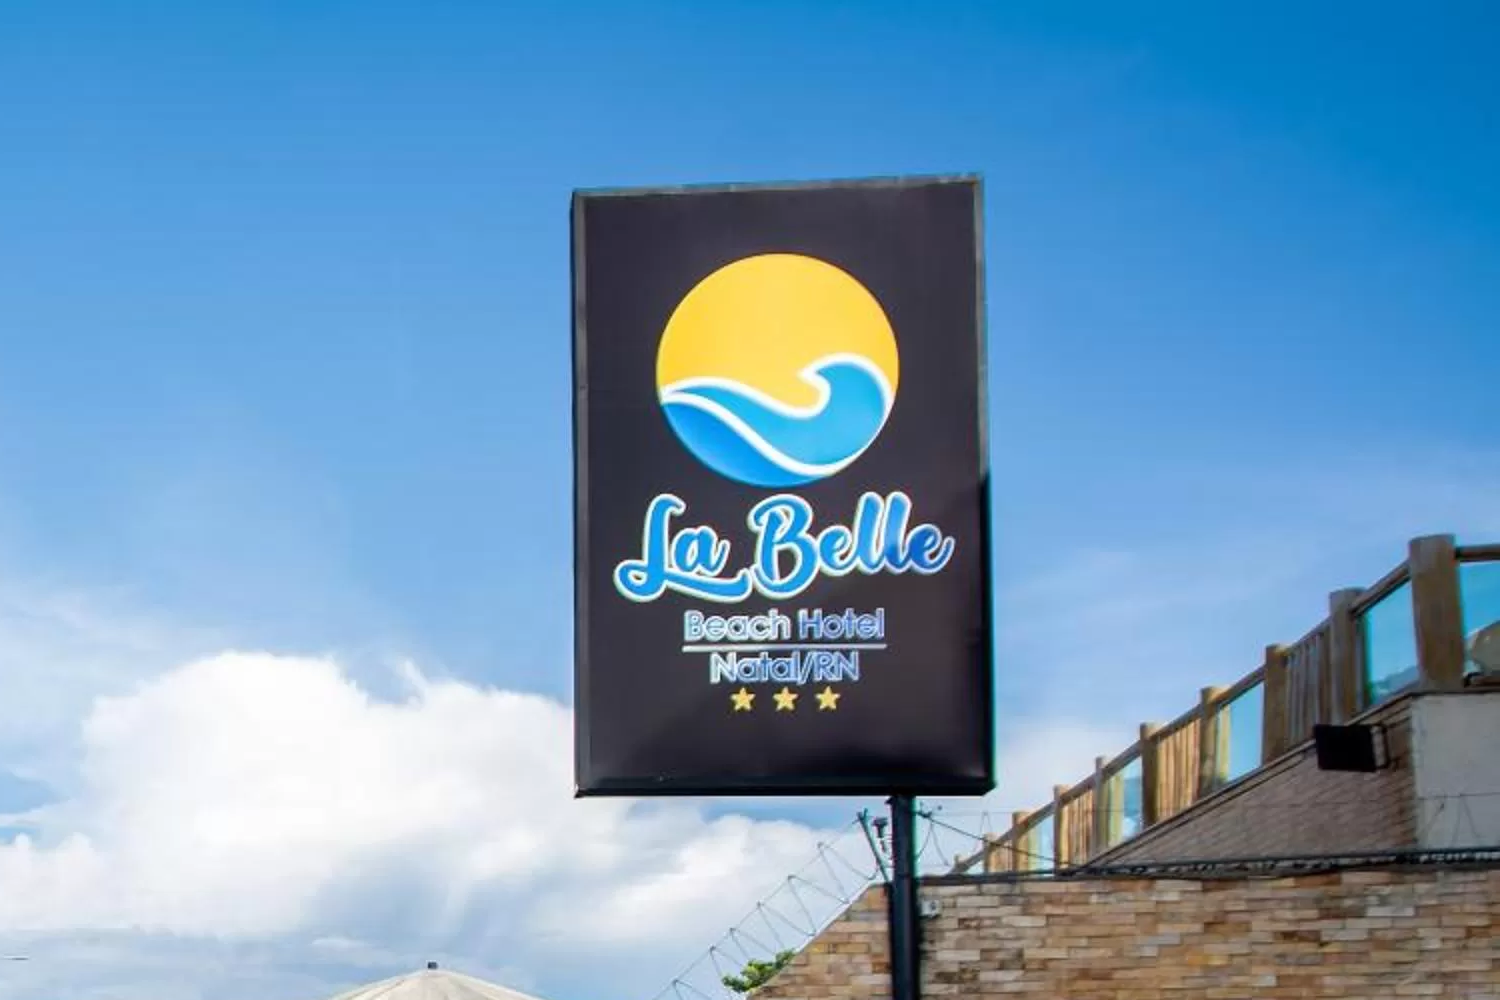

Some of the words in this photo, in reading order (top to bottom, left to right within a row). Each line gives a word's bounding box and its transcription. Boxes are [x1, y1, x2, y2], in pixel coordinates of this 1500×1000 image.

[613, 494, 753, 602] La
[748, 491, 955, 600] Belle
[683, 610, 790, 642] Beach
[800, 608, 886, 640] Hotel
[709, 650, 860, 685] Natal/RN
